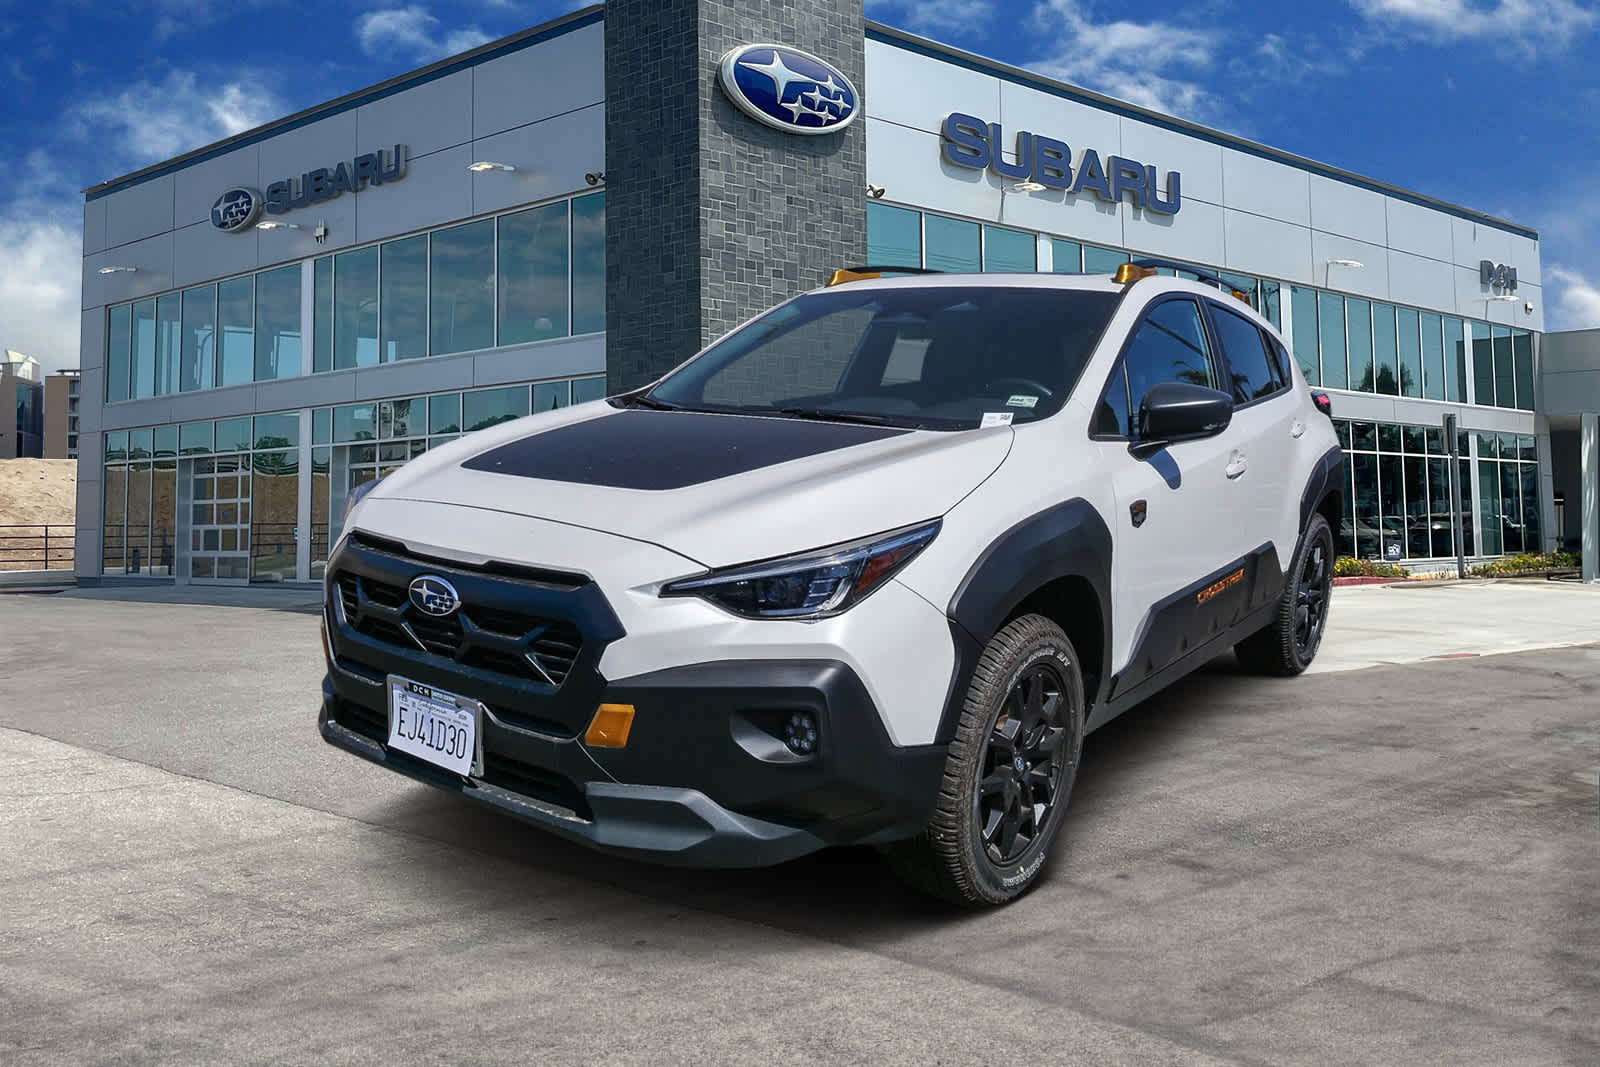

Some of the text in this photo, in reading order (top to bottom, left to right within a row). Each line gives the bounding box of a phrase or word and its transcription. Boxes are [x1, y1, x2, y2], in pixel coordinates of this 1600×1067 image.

[266, 143, 408, 215] SUBARU
[941, 112, 1181, 215] SUBARU
[397, 706, 467, 760] EJ41D30
